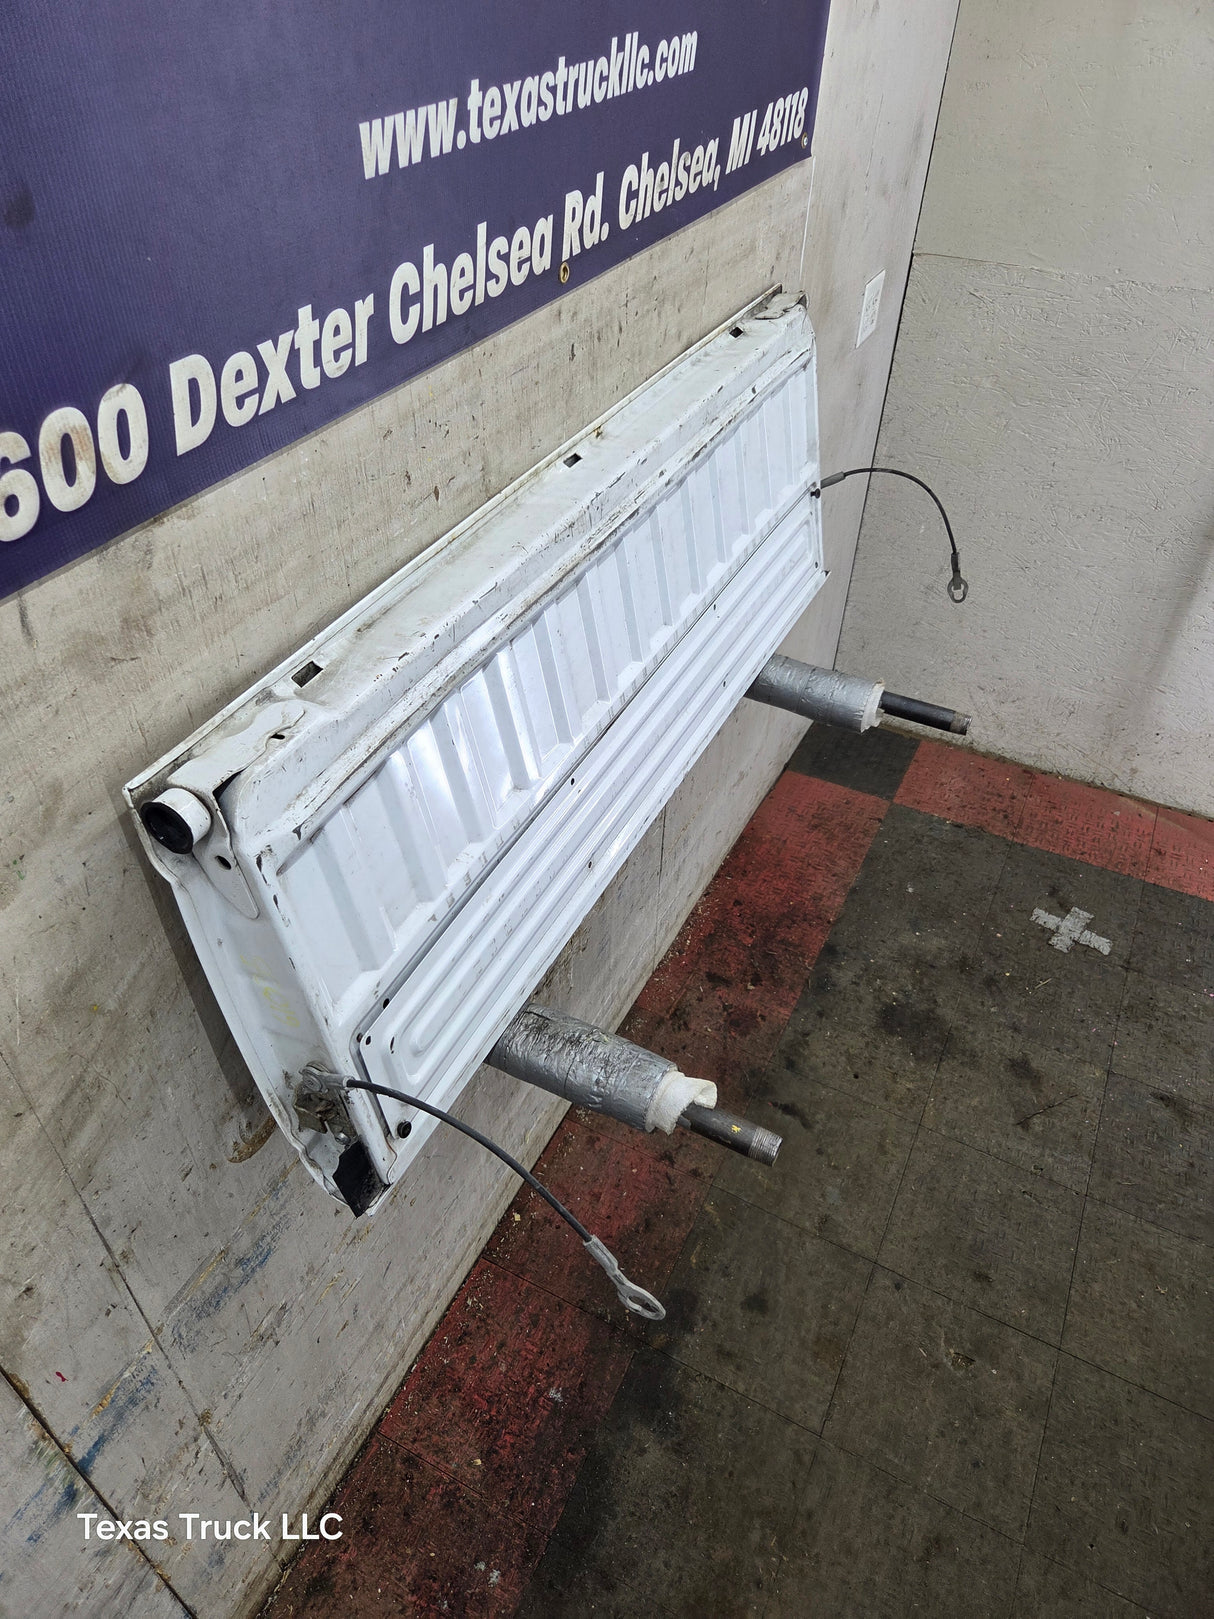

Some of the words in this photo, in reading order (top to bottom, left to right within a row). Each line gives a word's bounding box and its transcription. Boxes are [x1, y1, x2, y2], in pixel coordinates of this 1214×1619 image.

[359, 31, 699, 181] www.texastruckllc.com
[0, 383, 149, 542] 600
[169, 292, 375, 457] Dexter
[388, 213, 555, 345] Chelsea
[562, 170, 610, 262] Rd.
[619, 137, 721, 230] Chelsea,
[725, 108, 758, 175] MI
[757, 86, 809, 157] 48118
